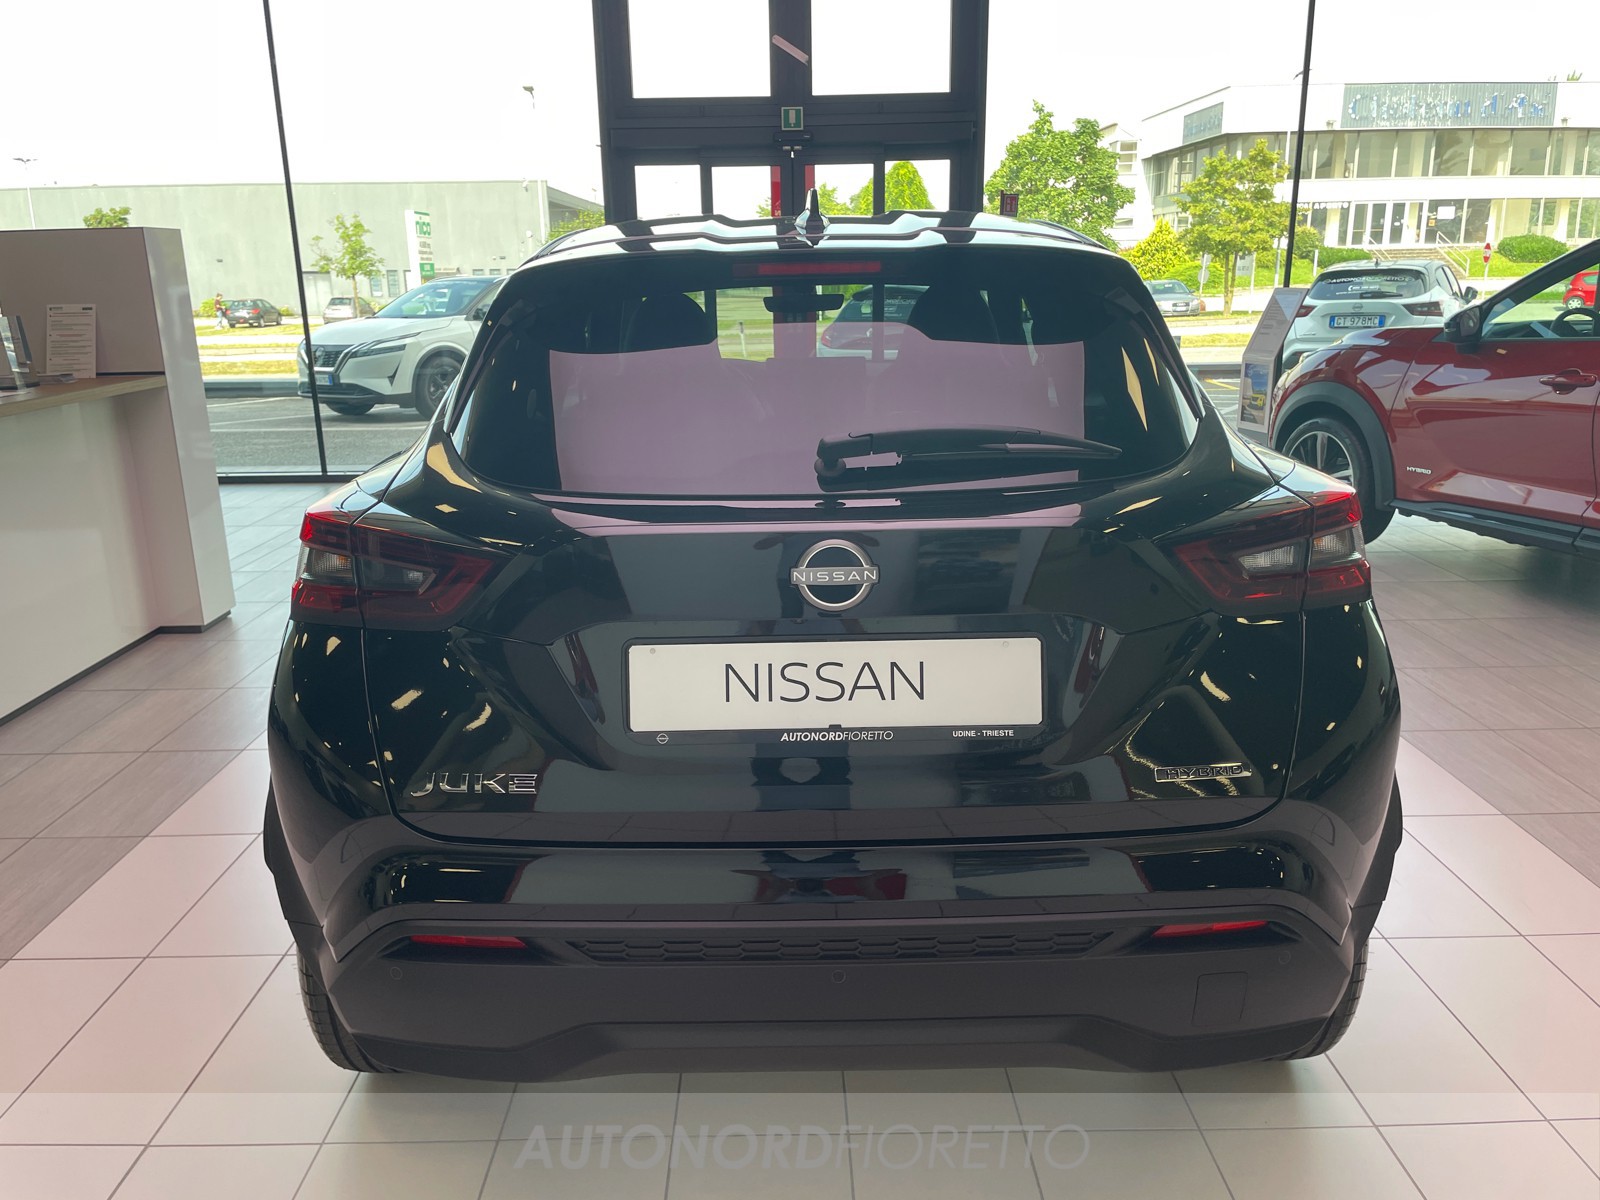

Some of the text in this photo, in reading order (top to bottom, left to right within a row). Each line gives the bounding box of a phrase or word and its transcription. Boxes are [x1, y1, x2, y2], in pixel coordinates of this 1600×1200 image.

[1350, 316, 1378, 326] 978MC
[793, 570, 878, 583] NISSAN
[725, 661, 925, 703] NISSAN
[780, 731, 894, 742] AUTONORDFIORETTO
[952, 730, 976, 738] UDINE
[982, 729, 1014, 738] TRIESTE
[1166, 766, 1242, 779] HYBRID
[410, 771, 538, 796] JUKE
